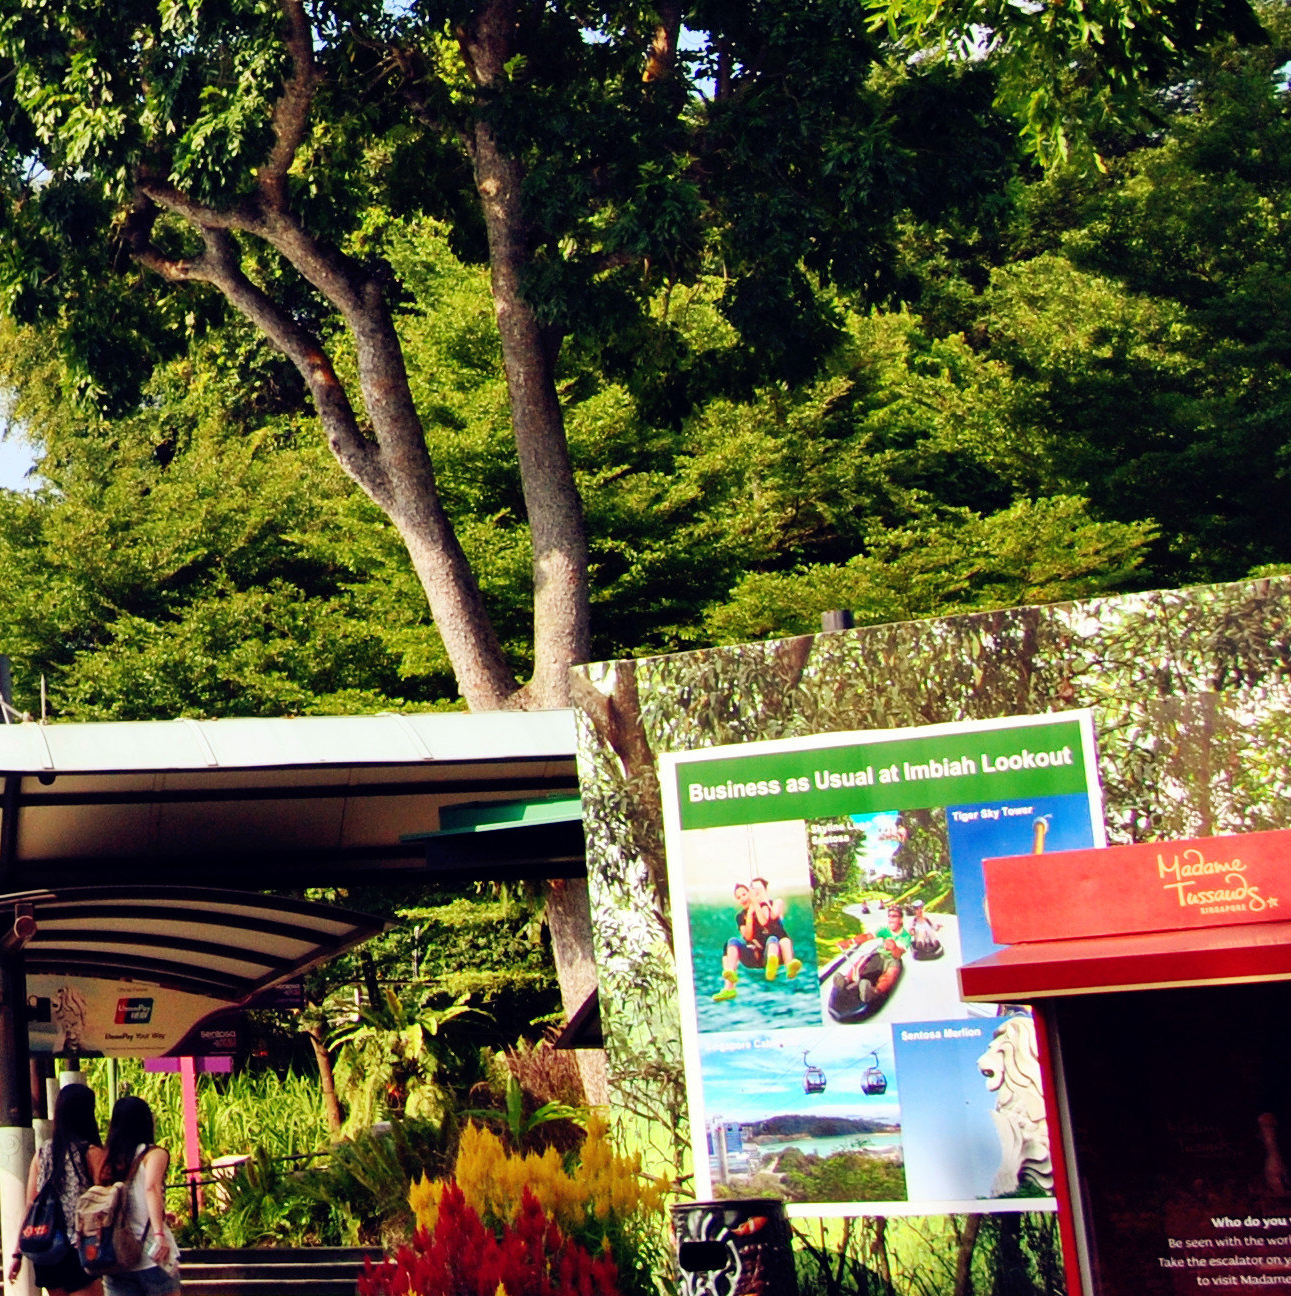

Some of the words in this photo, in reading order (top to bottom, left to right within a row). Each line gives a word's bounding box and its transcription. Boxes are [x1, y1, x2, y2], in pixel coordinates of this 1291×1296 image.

[688, 781, 781, 803] Business
[785, 777, 810, 794] as
[814, 766, 875, 790] Usual
[878, 764, 901, 783] at
[903, 755, 977, 781] Imbiah
[981, 746, 1073, 774] Lookout
[951, 811, 979, 823] Tiger
[980, 808, 1000, 820] Sky
[1001, 806, 1034, 817] Tower
[1157, 848, 1248, 881] Madame
[1163, 872, 1267, 912] Tussauds
[1200, 904, 1247, 915] SINGAPORE
[901, 1030, 942, 1041] Sentosa
[943, 1027, 982, 1039] Merlion
[1211, 1215, 1242, 1229] Who
[1243, 1215, 1261, 1228] do
[1262, 1216, 1288, 1230] you
[1168, 1238, 1183, 1249] Be
[1185, 1237, 1214, 1248] seen
[1215, 1235, 1242, 1247] with
[1244, 1235, 1265, 1246] the
[1158, 1256, 1185, 1268] Take
[1186, 1255, 1208, 1267] the
[1208, 1254, 1263, 1267] escalator
[1266, 1256, 1282, 1266] on
[1196, 1275, 1211, 1287] to
[1211, 1274, 1238, 1286] visit
[1240, 1274, 1291, 1285] Madame
